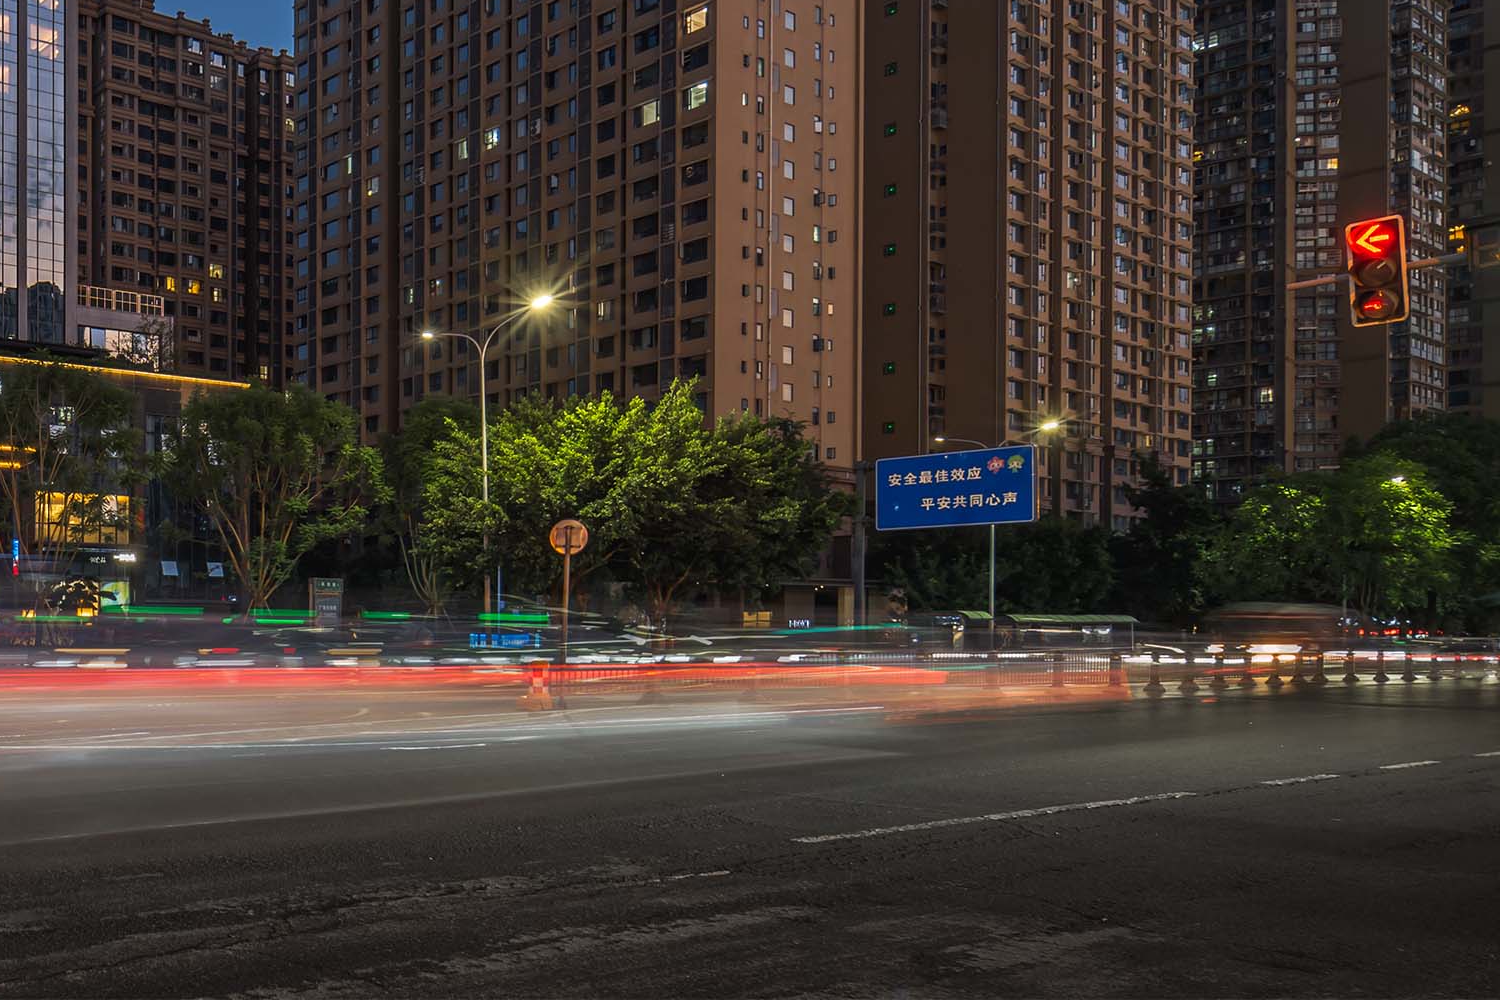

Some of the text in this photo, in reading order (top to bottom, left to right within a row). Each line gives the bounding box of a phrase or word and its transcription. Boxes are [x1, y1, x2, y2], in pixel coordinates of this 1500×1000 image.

[888, 466, 982, 487] 安全最佳效应
[920, 491, 1018, 511] 平安共同心声
